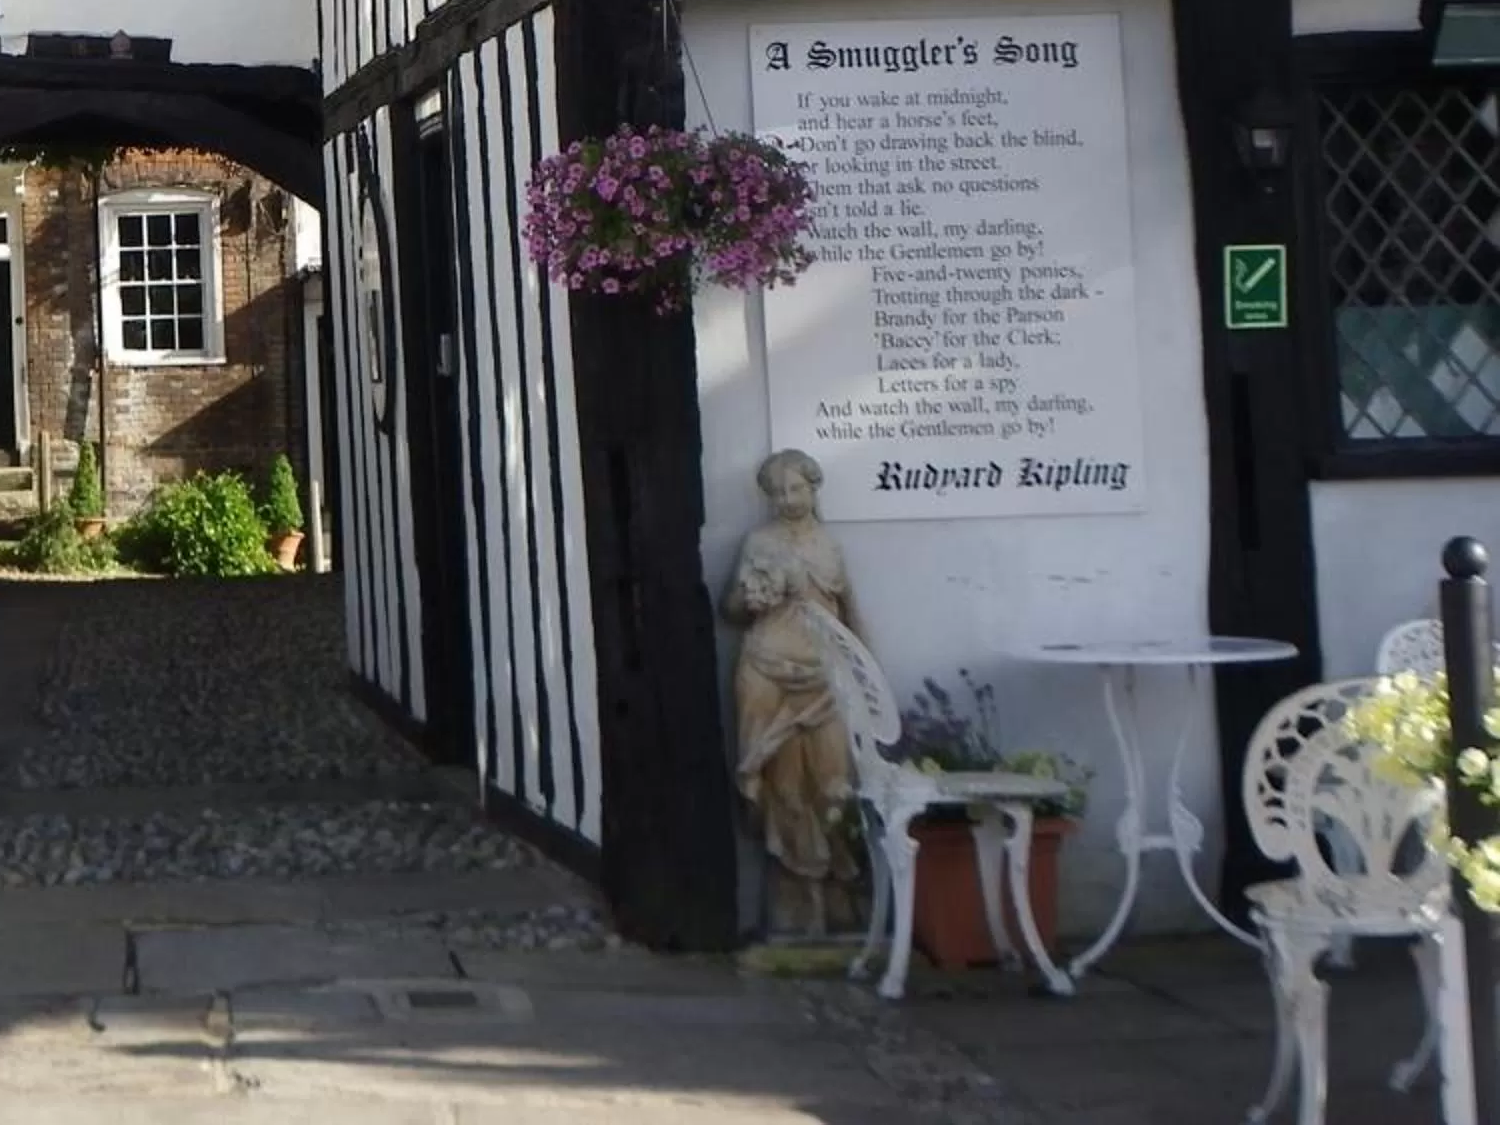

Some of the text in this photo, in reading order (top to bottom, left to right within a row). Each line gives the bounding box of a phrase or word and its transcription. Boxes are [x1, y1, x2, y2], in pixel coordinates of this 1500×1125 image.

[765, 36, 1079, 72] A Smuggler's Song
[797, 87, 1009, 111] If you wake at midnight,
[798, 114, 829, 131] and
[836, 113, 873, 129] hear
[880, 117, 891, 128] a
[896, 110, 956, 128] horse's
[800, 135, 848, 152] Don't
[855, 138, 875, 155] go
[880, 133, 948, 153] drawing
[954, 131, 994, 149] back
[1001, 131, 1028, 148] the
[825, 157, 889, 176] looking
[896, 156, 913, 172] in
[918, 155, 946, 172] the
[858, 179, 891, 195] that
[896, 177, 925, 194] ask
[932, 180, 953, 193] no
[959, 176, 1040, 197] questions
[846, 200, 878, 217] told
[883, 204, 894, 217] a
[807, 223, 858, 241] Watch
[863, 222, 891, 239] the
[896, 221, 939, 239] wall,
[943, 224, 969, 241] my
[807, 240, 1044, 262] while the Gentlemen go by!
[872, 265, 1012, 283] Five-and-twenty
[872, 288, 940, 307] Trotting
[946, 285, 1013, 305] through
[1018, 284, 1045, 300] the
[1050, 283, 1090, 300] dark
[874, 307, 1065, 329] Brandy for the Parson
[943, 331, 967, 348] for
[973, 330, 1000, 346] the
[877, 354, 927, 372] Laces
[932, 353, 957, 371] for
[962, 357, 973, 369] a
[878, 375, 1017, 395] Letters for a spy
[815, 400, 852, 418] And
[858, 398, 909, 416] watch
[915, 397, 943, 415] the
[948, 396, 990, 415] wall,
[995, 399, 1019, 415] my
[815, 417, 1055, 440] while the Gentlemen go by!
[874, 457, 1130, 496] Rudyard Kipling
